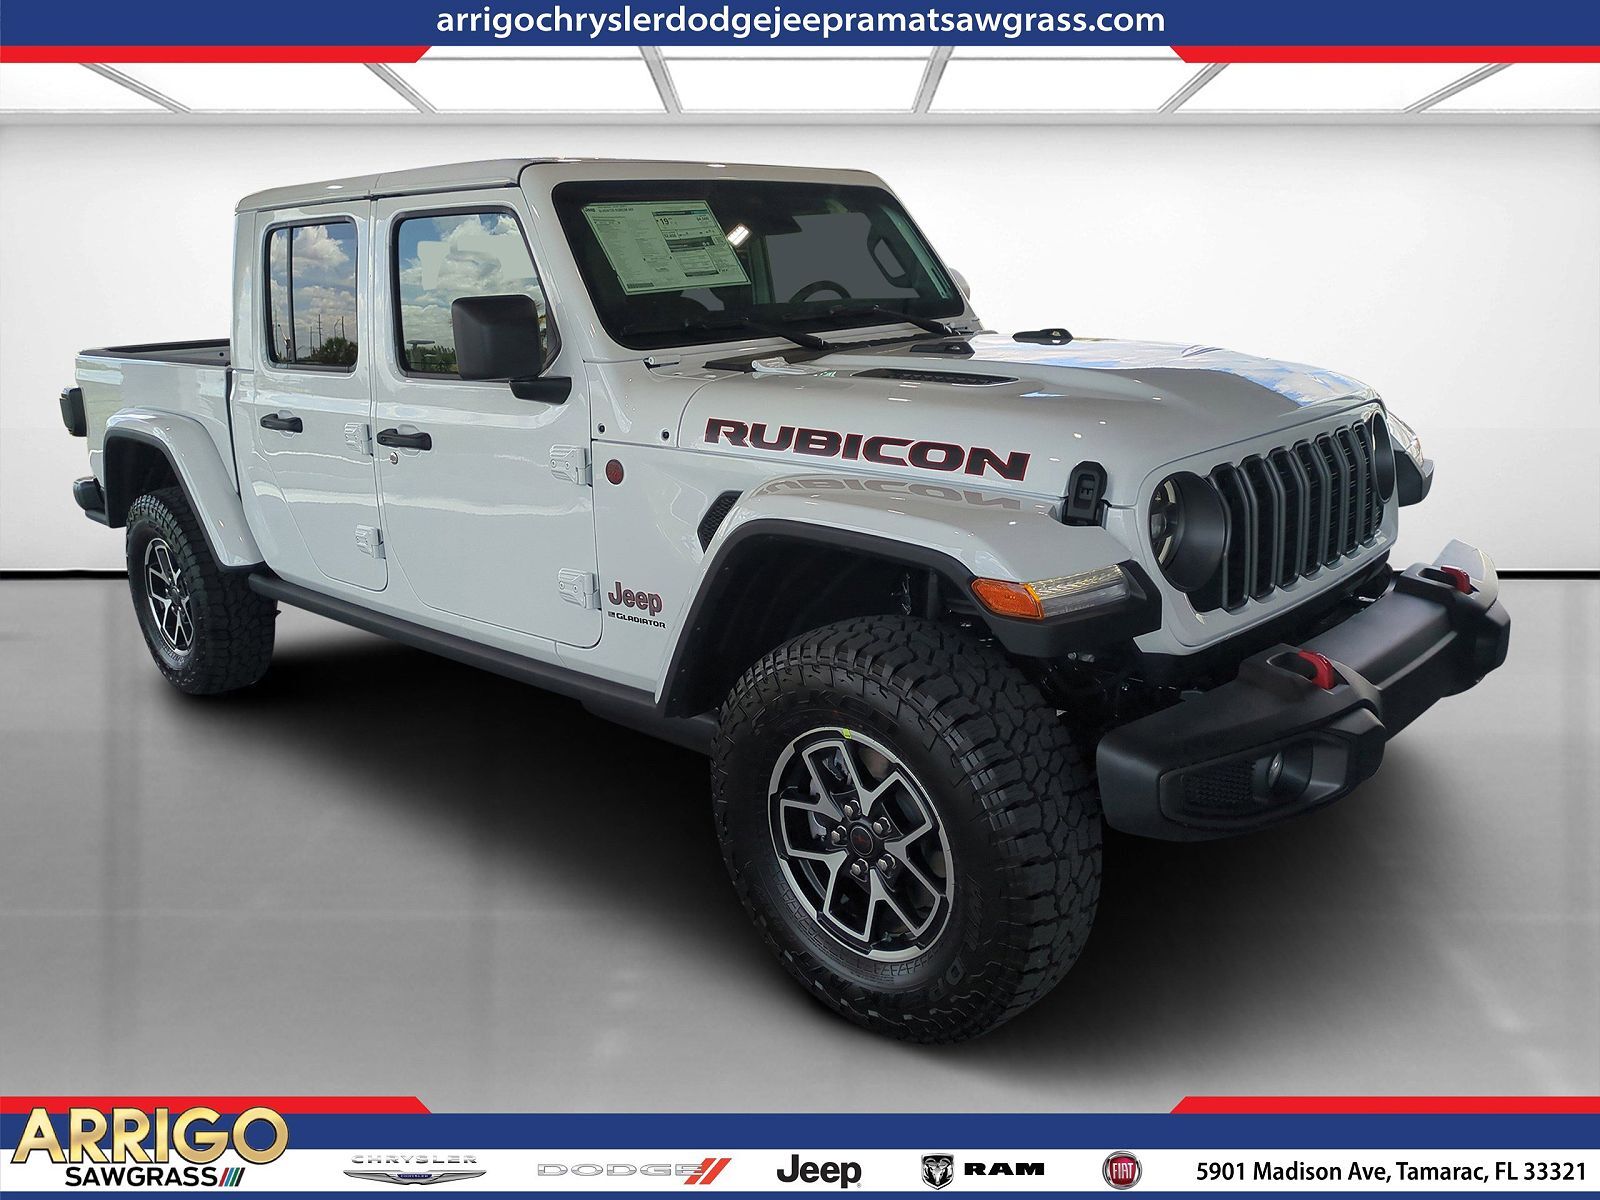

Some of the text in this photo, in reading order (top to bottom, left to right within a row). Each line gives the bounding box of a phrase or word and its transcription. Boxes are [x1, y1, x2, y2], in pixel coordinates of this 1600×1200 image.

[704, 417, 1031, 481] RUBICON
[608, 581, 663, 616] Jeep
[616, 612, 666, 629] GLADIATOR
